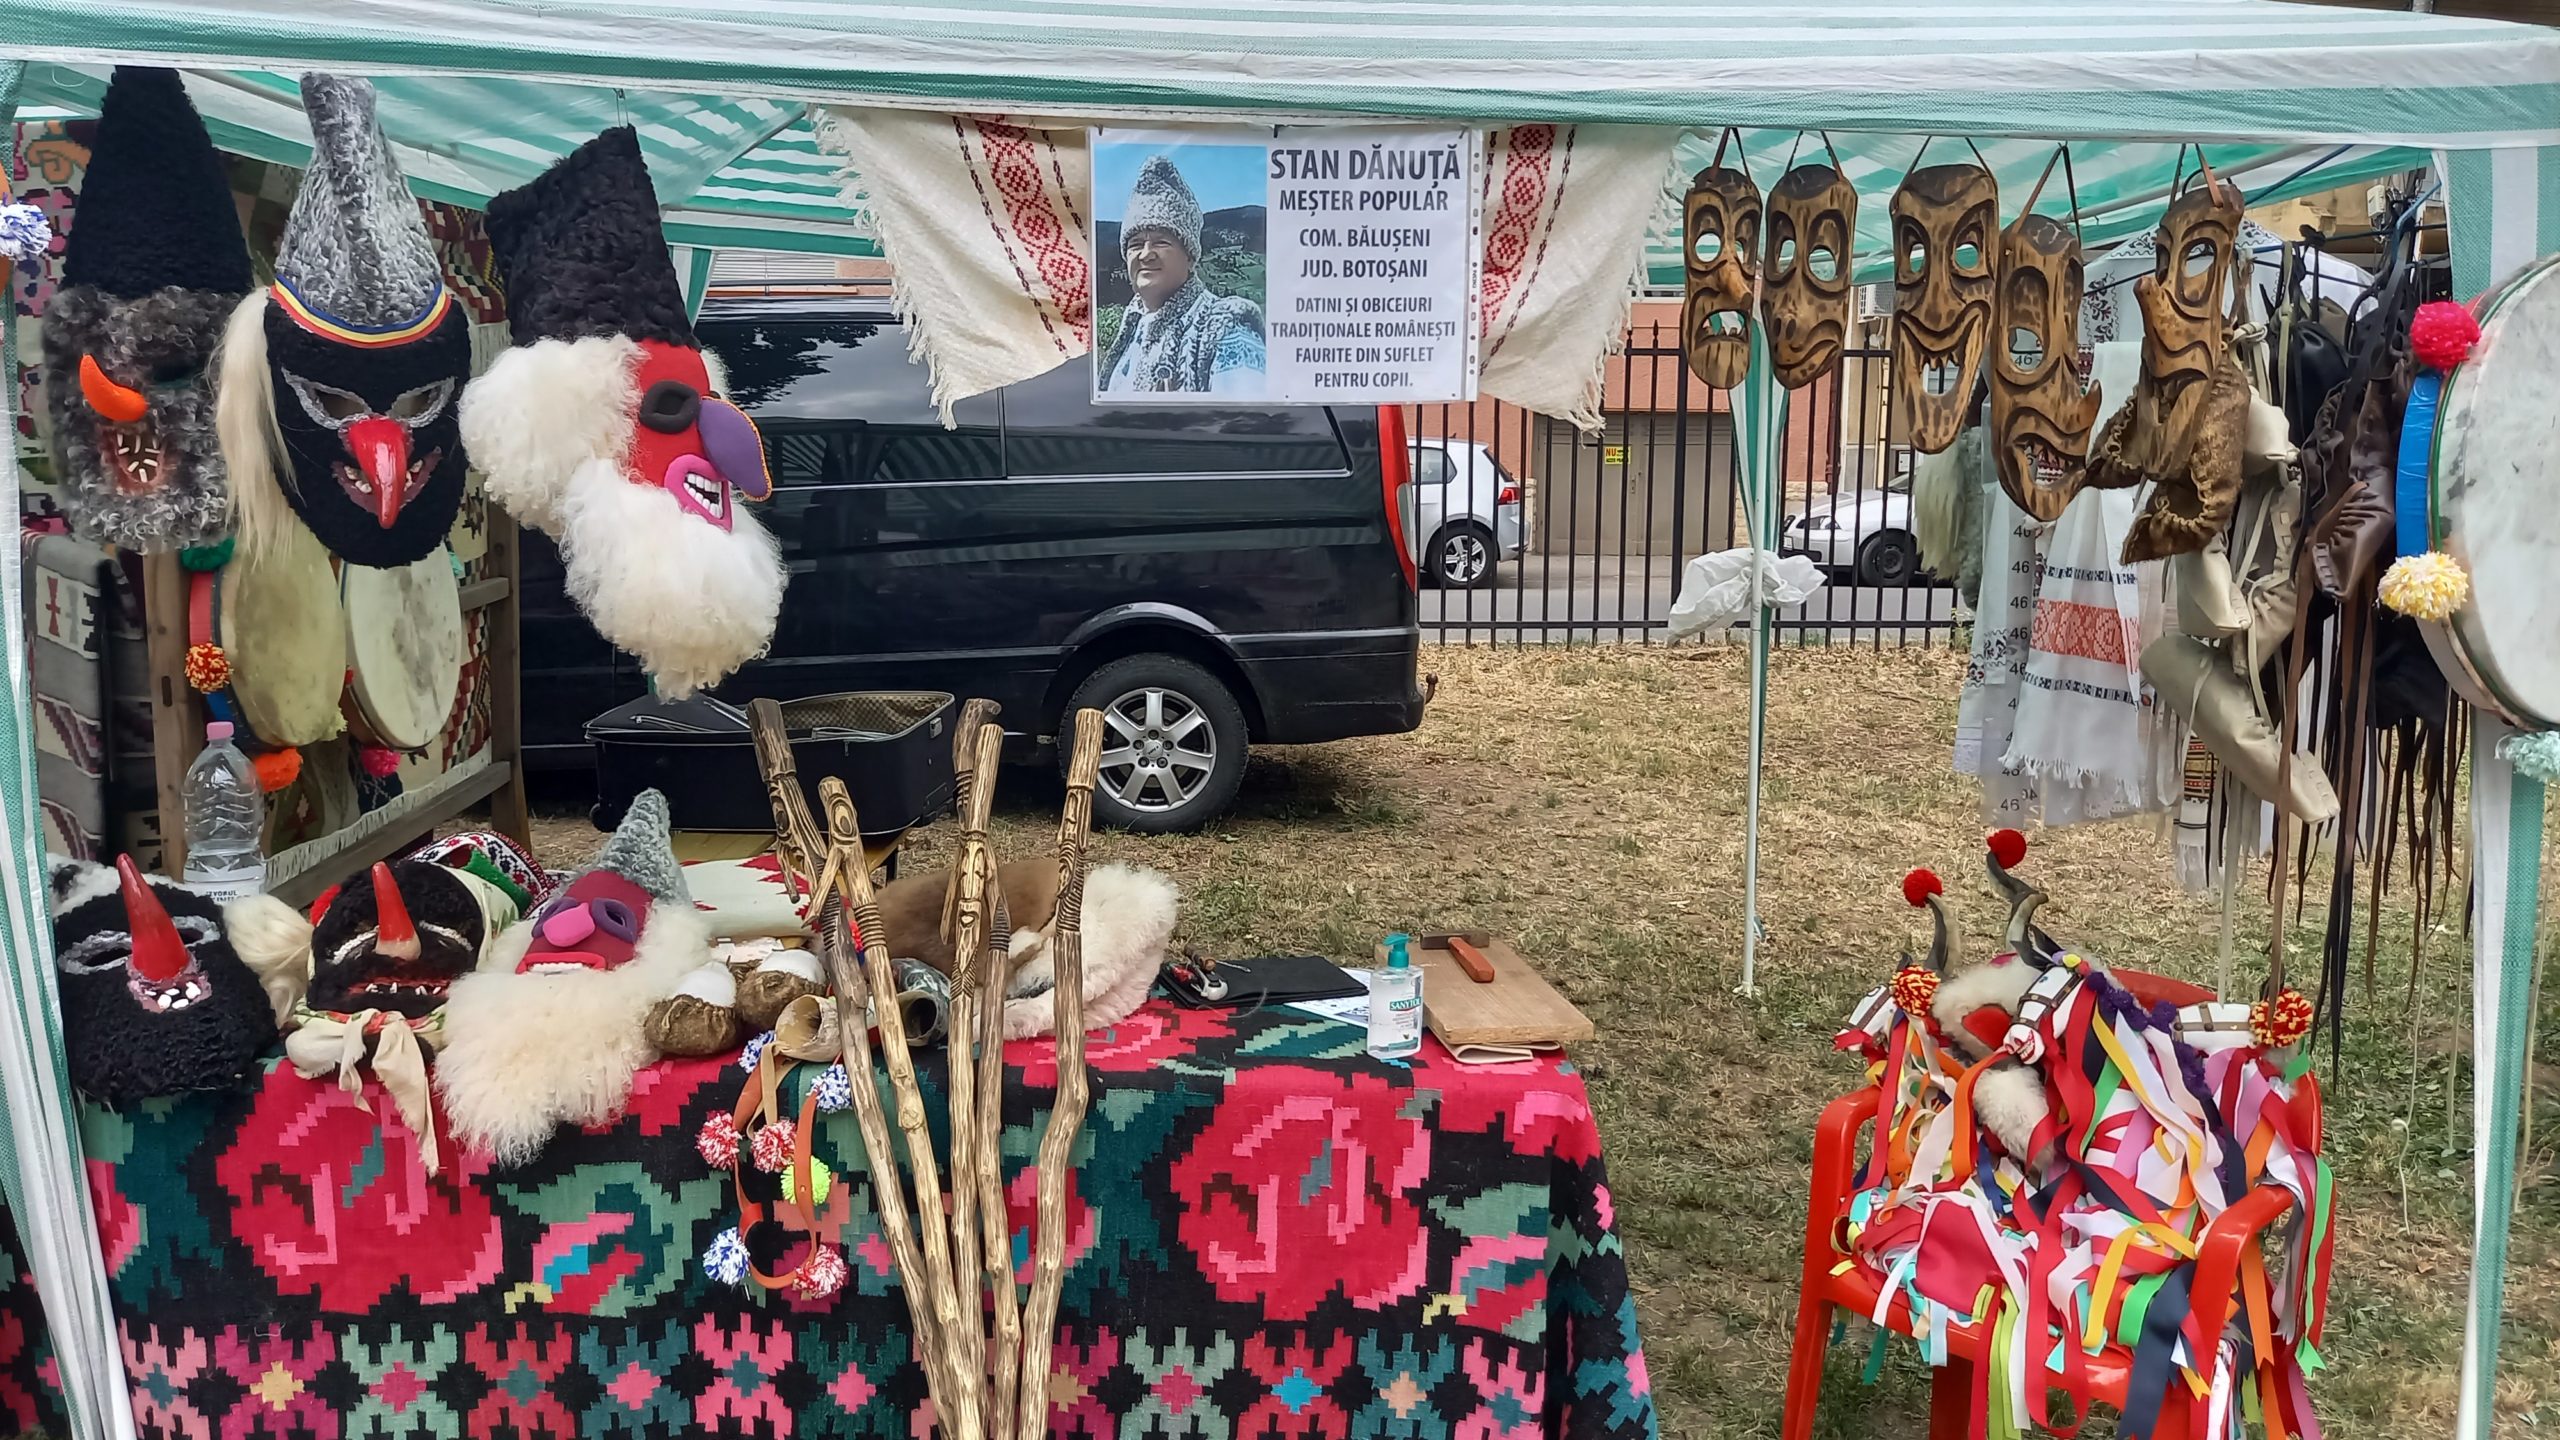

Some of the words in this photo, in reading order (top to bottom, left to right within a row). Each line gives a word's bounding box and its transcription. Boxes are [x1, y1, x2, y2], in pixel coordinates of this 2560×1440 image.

[1270, 149, 1339, 180] STAN
[1349, 143, 1460, 188] DĂNUȚĂ
[1279, 190, 1354, 217] MEȘTER
[1359, 190, 1448, 211] POPULAR
[1299, 228, 1342, 247] COM.
[1347, 224, 1430, 252] BĂLUȘENI
[1300, 259, 1338, 278] JUD.
[1343, 259, 1428, 283] BOTOȘANI
[1295, 297, 1342, 313] DATINI
[1345, 297, 1358, 317] ȘI
[1361, 297, 1432, 313] OBICEIURI
[1271, 322, 1371, 342] TRADIȚIONALE
[1375, 319, 1455, 341] ROMÂNEȘTI
[1295, 347, 1352, 363] FAURITE
[1355, 347, 1380, 363] DIN
[1384, 347, 1434, 363] SUFLET
[2014, 354, 2033, 366] 46
[1314, 372, 1369, 388] PENTRU
[1372, 372, 1414, 387] COPII.
[1606, 448, 1617, 456] NU
[2011, 560, 2030, 574] 46
[2010, 596, 2029, 609] 46
[2009, 627, 2028, 640] 46
[2000, 798, 2020, 811] 46
